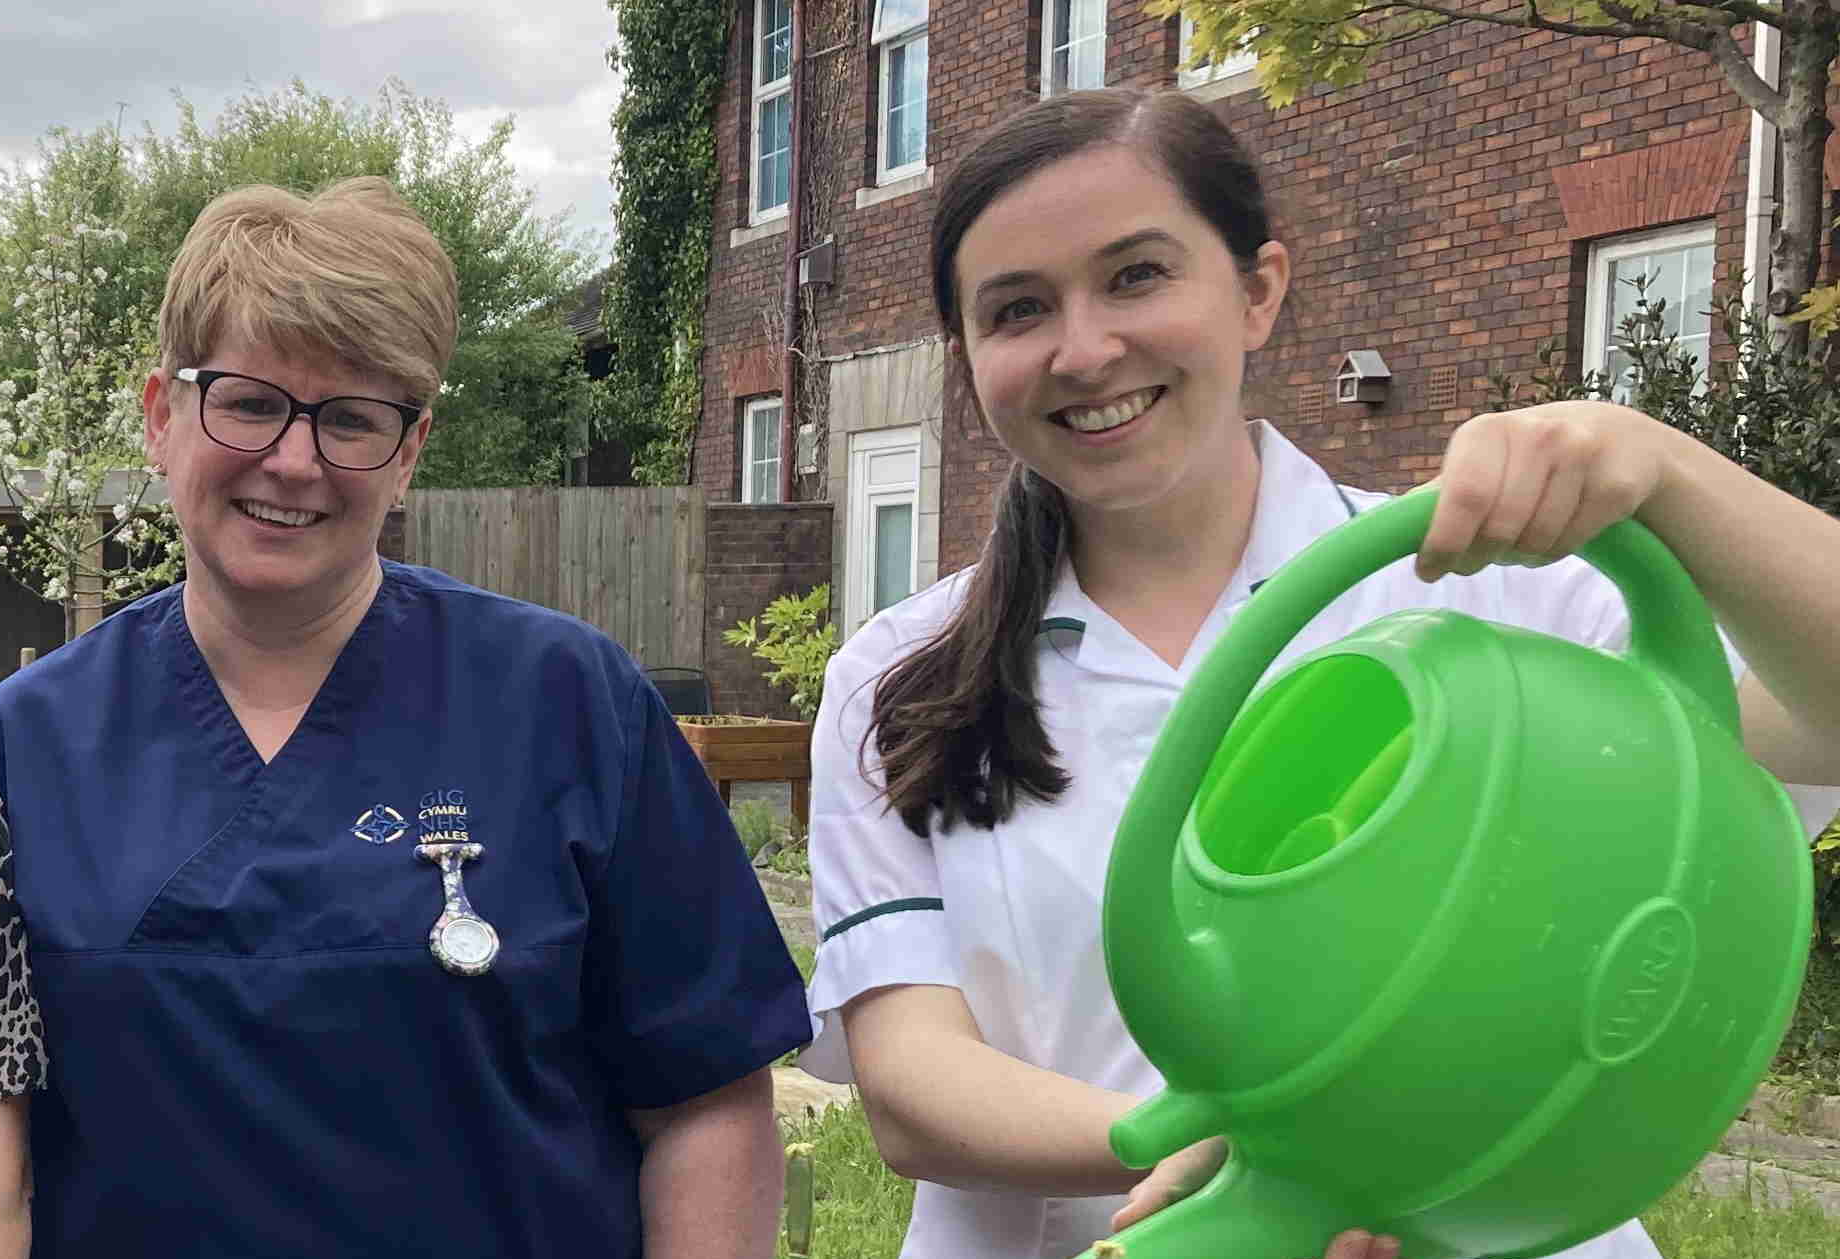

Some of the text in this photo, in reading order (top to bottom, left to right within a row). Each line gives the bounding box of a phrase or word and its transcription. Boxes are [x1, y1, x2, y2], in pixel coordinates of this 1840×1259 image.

[419, 789, 465, 808] GIG
[418, 805, 467, 819] CYMRU
[418, 816, 467, 834] NHS
[419, 830, 469, 843] WALES
